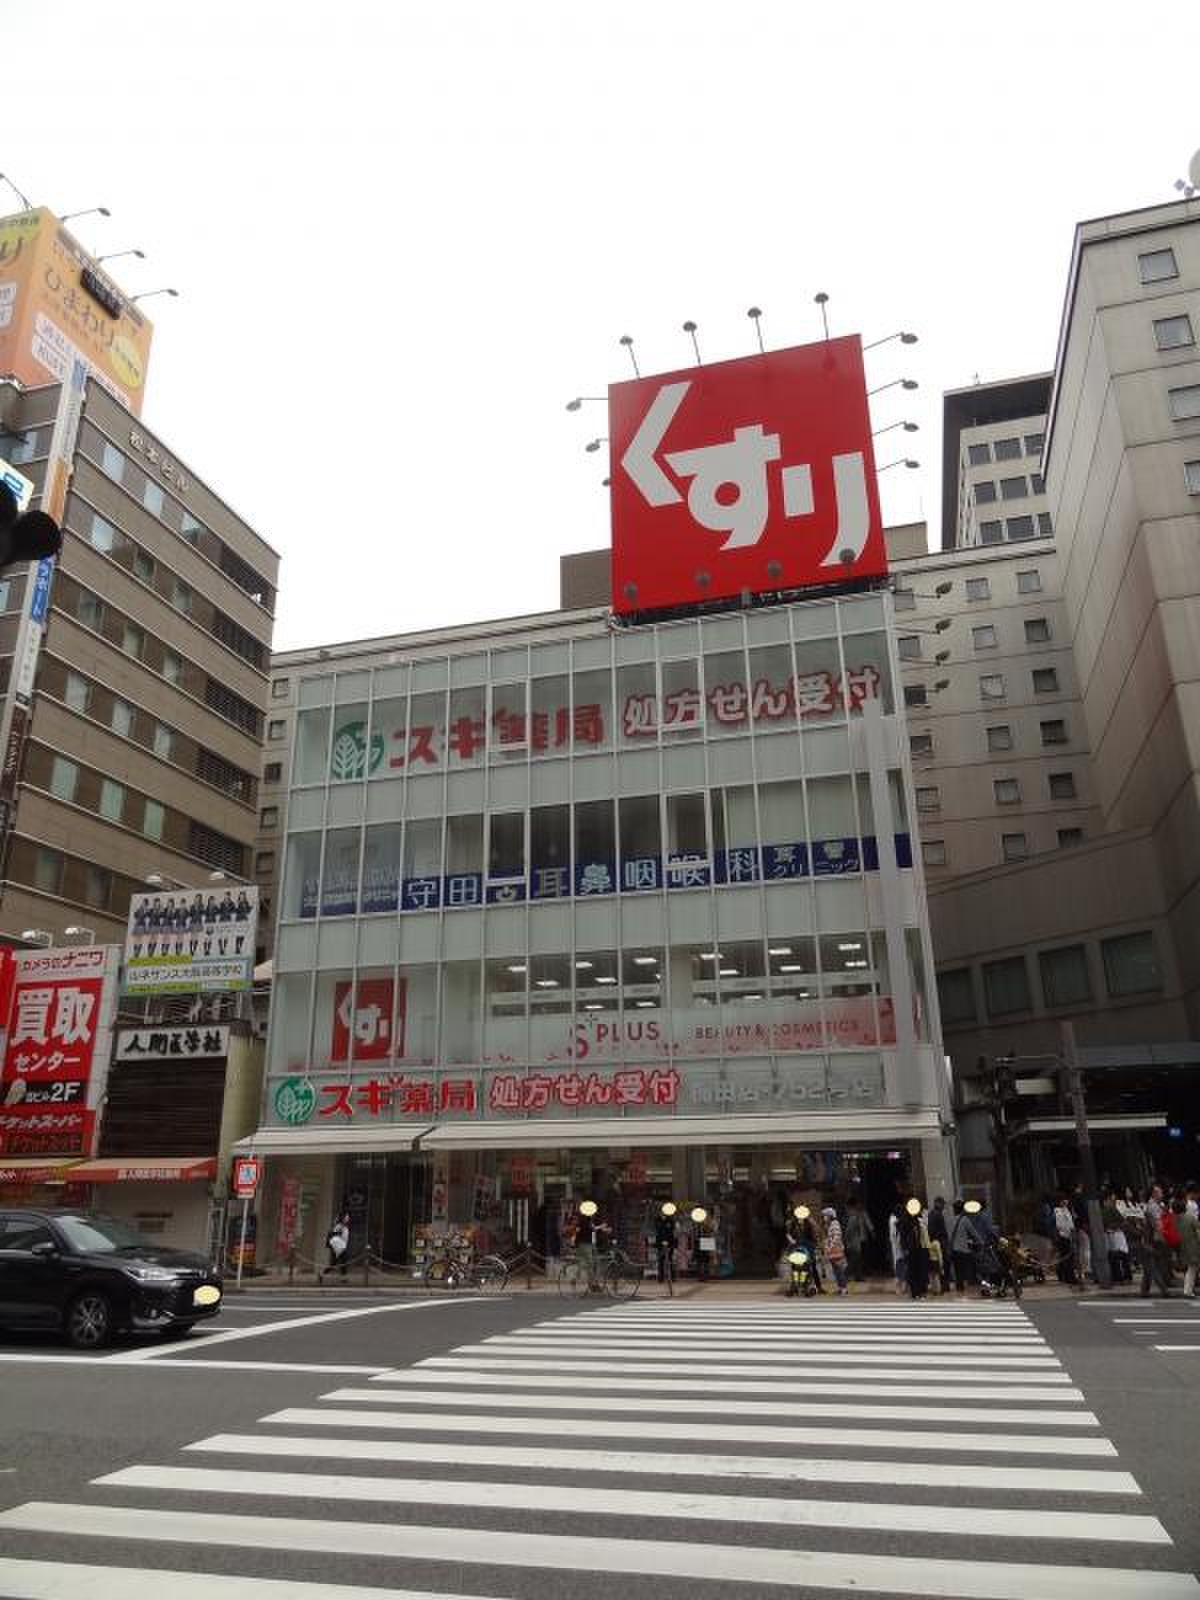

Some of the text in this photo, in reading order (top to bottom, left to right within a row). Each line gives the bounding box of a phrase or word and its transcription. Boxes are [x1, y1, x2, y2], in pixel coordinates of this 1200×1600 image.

[621, 381, 870, 566] くすり
[389, 664, 880, 768] スギ薬局 処方せん受付
[10, 988, 96, 1045] 買取
[596, 1022, 660, 1043] PLUS
[15, 1051, 81, 1073] センター
[320, 1076, 475, 1116] スギ薬局
[490, 1069, 680, 1110] 処方せん受付
